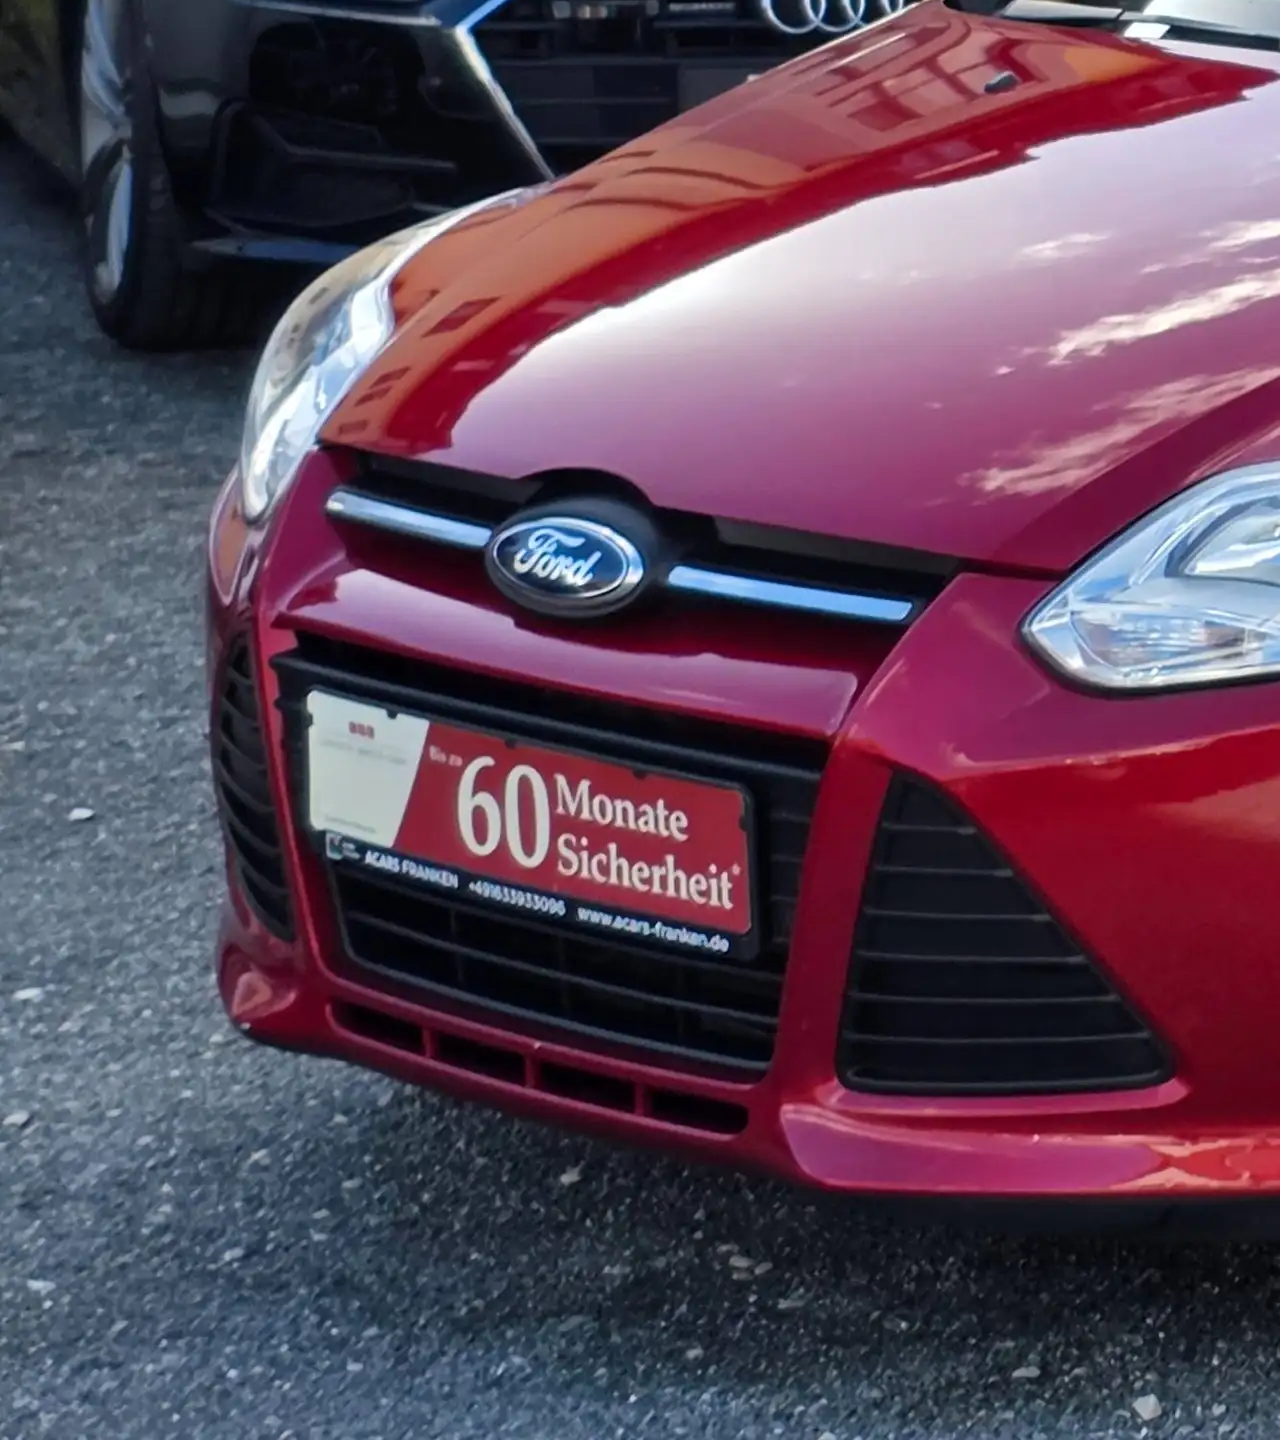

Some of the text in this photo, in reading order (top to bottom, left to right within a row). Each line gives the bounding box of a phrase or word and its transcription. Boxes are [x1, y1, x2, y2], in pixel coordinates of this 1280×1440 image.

[513, 527, 602, 587] Ford
[458, 756, 550, 868] 60
[553, 773, 689, 842] Monate
[364, 849, 400, 873] ACARS
[401, 859, 459, 889] FRANKEN
[577, 906, 730, 953] www.acars-franken.de
